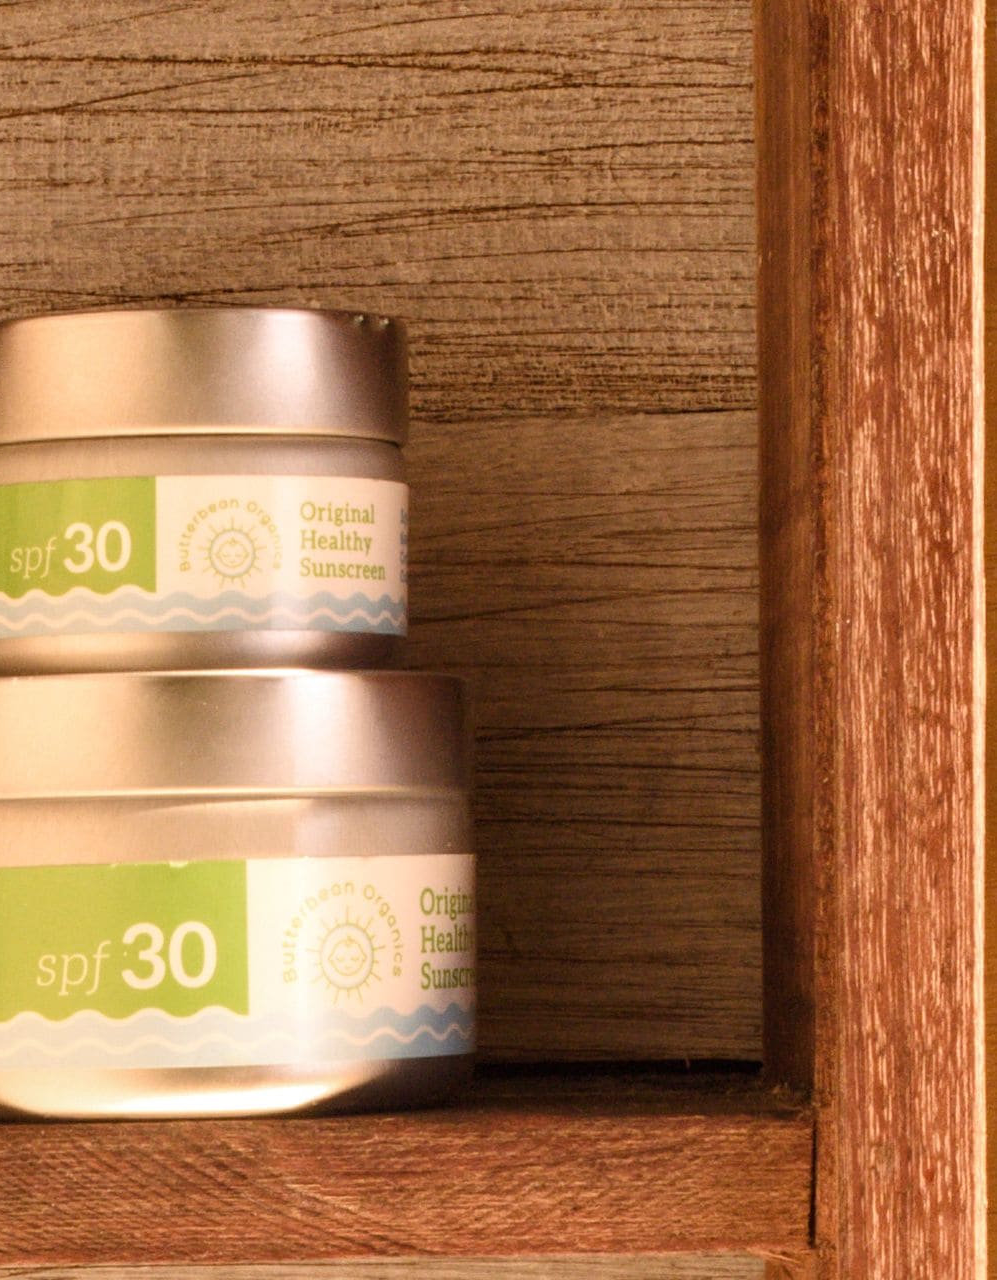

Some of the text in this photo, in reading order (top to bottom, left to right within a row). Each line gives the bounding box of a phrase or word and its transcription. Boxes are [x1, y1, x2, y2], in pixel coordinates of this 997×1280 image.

[179, 499, 240, 573] Butterbean
[300, 502, 375, 525] Original
[10, 520, 132, 577] spf 30
[300, 531, 373, 557] Healthy
[300, 558, 386, 581] Sunscreen
[35, 921, 217, 996] spf 30
[283, 881, 403, 984] Butterbean Organics
